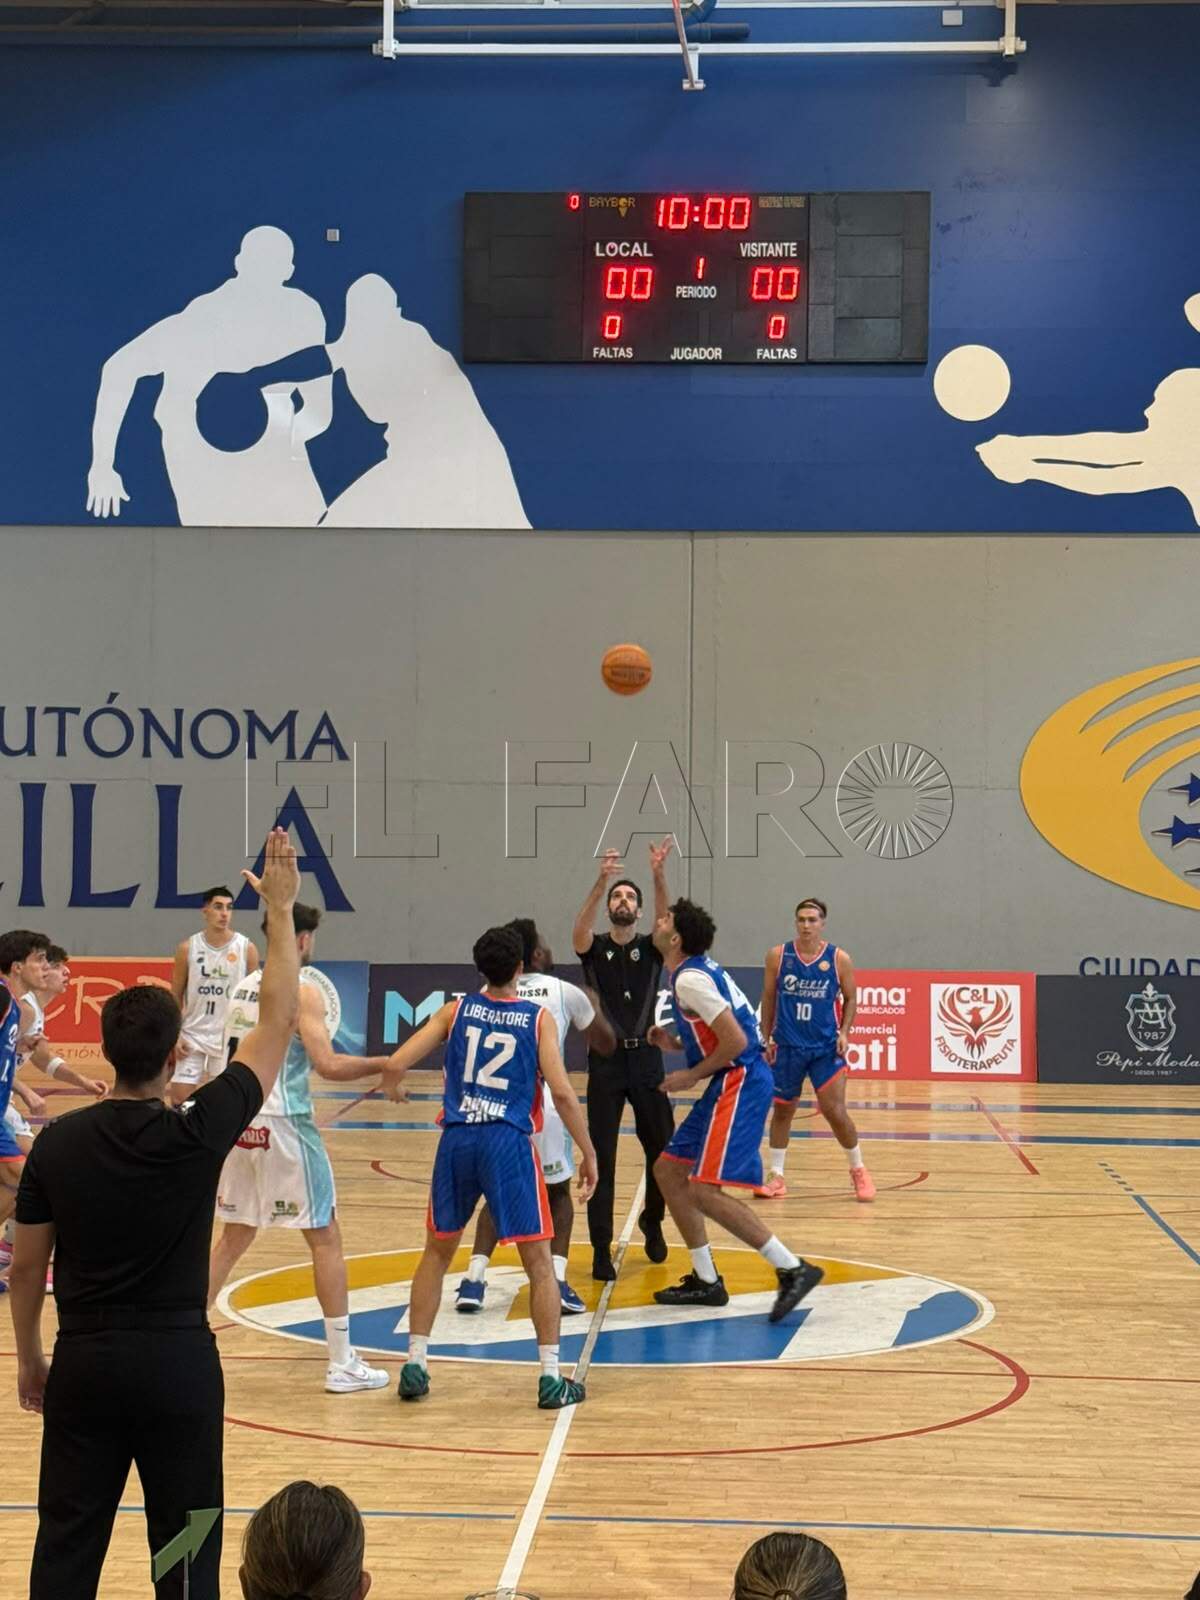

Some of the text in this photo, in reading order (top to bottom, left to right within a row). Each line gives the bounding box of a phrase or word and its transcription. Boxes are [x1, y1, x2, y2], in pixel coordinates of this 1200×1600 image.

[656, 196, 751, 230] 10:00
[595, 241, 653, 257] LOCAL
[740, 242, 798, 257] VISITANTE
[605, 267, 653, 300] 00
[675, 285, 717, 299] PERIODO
[751, 267, 799, 300] 00
[604, 315, 621, 340] 0
[768, 315, 785, 340] 0
[592, 347, 634, 360] FALTAS
[670, 347, 723, 361] JUGADOR
[756, 348, 798, 360] FALTAS
[0, 782, 356, 913] ILLA
[956, 986, 995, 1004] C&L
[463, 1003, 532, 1029] LIBERATORE
[796, 1002, 812, 1021] 10
[1137, 1031, 1166, 1040] 1987
[54, 1045, 102, 1060] STIÓN
[463, 1025, 517, 1091] 12
[934, 1034, 1018, 1071] FISIOTERAPEUTA
[1096, 1050, 1144, 1072] Pepi
